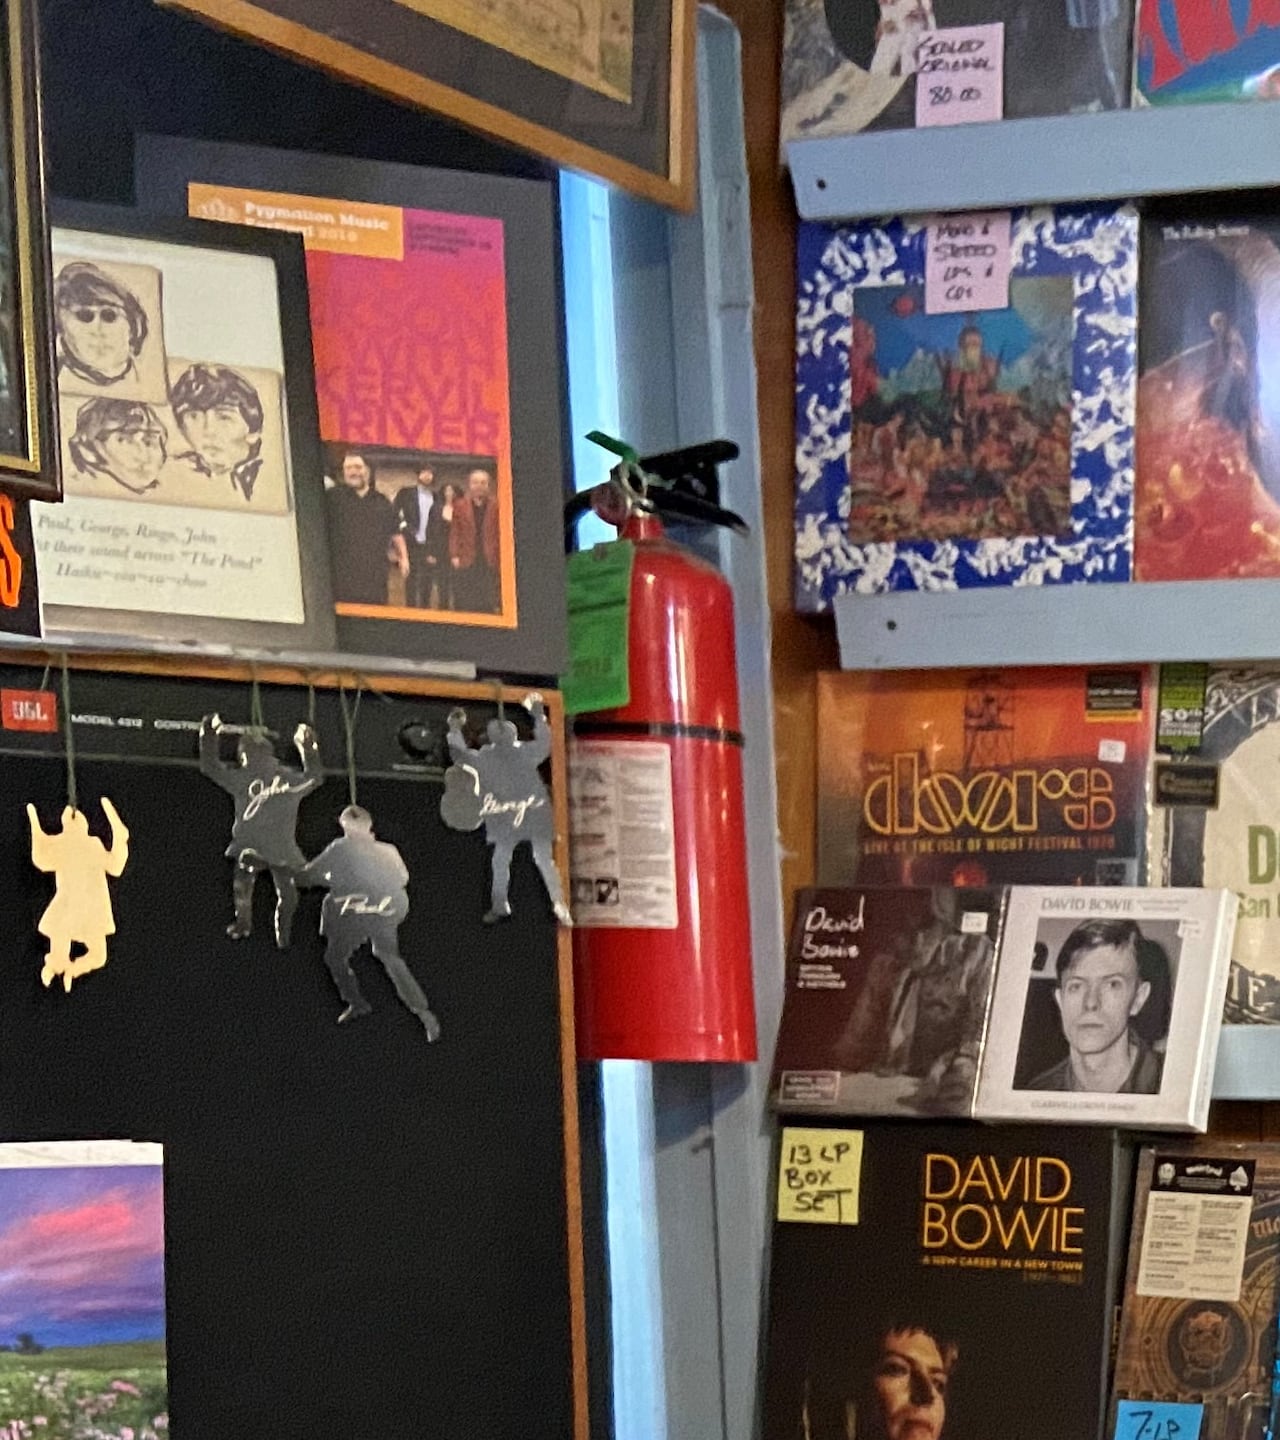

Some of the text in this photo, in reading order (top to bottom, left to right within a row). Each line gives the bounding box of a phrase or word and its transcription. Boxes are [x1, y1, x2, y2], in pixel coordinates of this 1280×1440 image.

[804, 894, 865, 934] David
[1041, 897, 1133, 913] DAVID BOWIE
[1236, 891, 1271, 919] San
[788, 1141, 851, 1165] 13 LP
[784, 1166, 833, 1191] BOX
[924, 1153, 1071, 1203] DAVID
[792, 1188, 853, 1224] SET
[923, 1203, 1086, 1254] BOWIE
[1050, 1260, 1084, 1272] TOWN
